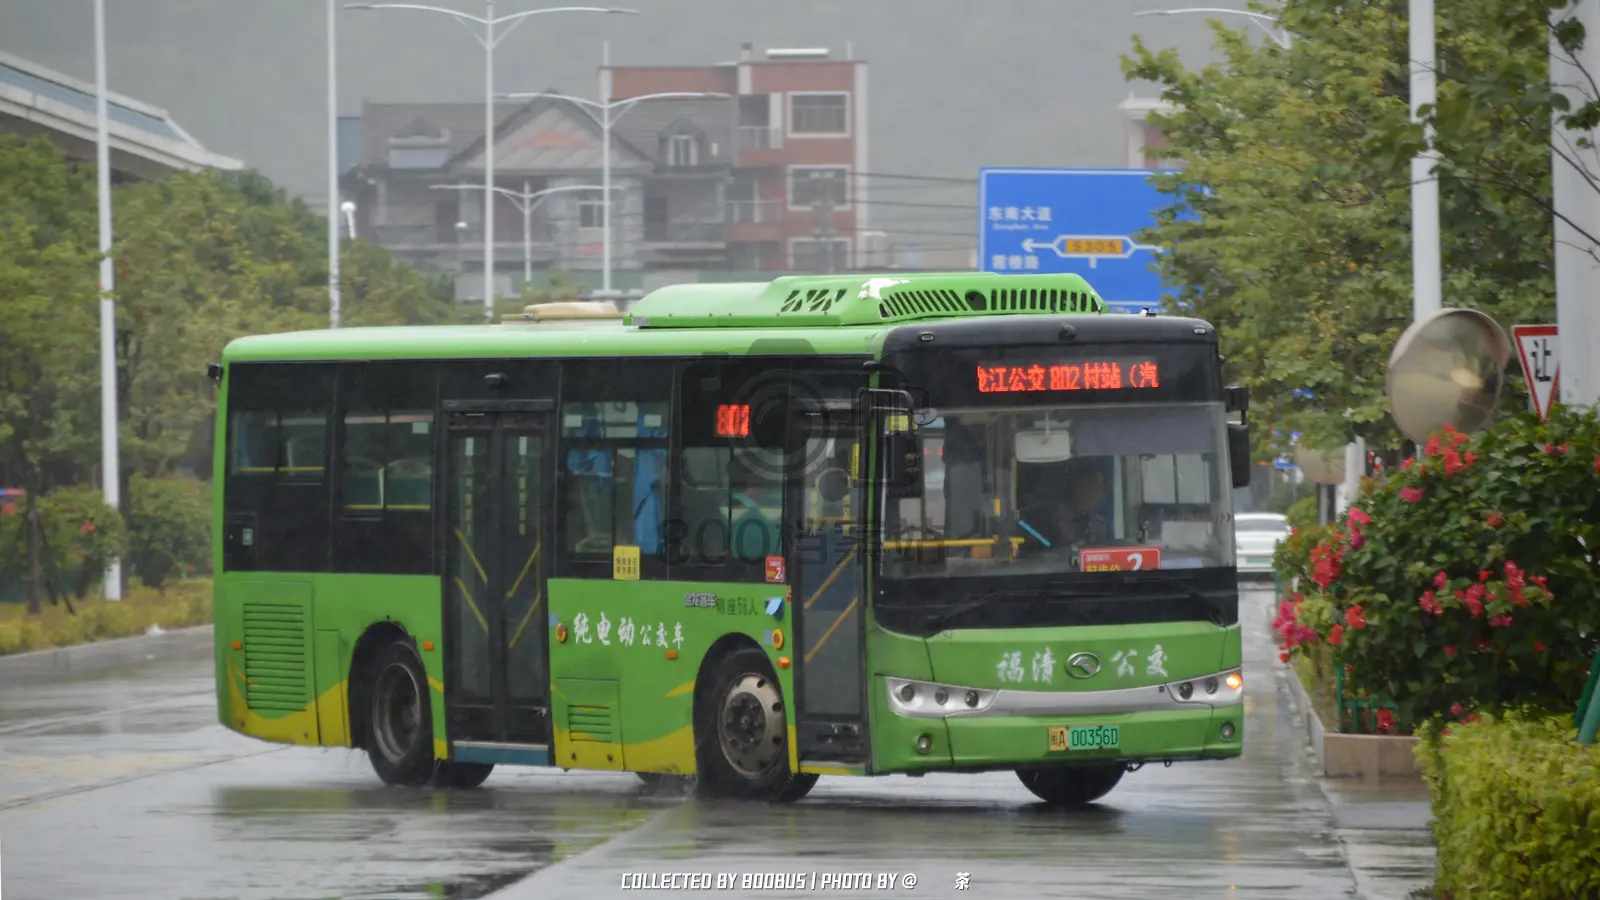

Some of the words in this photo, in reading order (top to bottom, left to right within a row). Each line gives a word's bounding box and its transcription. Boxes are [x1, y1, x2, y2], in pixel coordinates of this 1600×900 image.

[1050, 365, 1081, 390] 802
[1531, 339, 1552, 382] 让
[716, 404, 750, 436] 802
[573, 612, 684, 650] 纯电动公交车
[996, 647, 1055, 684] 福清
[1110, 644, 1169, 678] 公交
